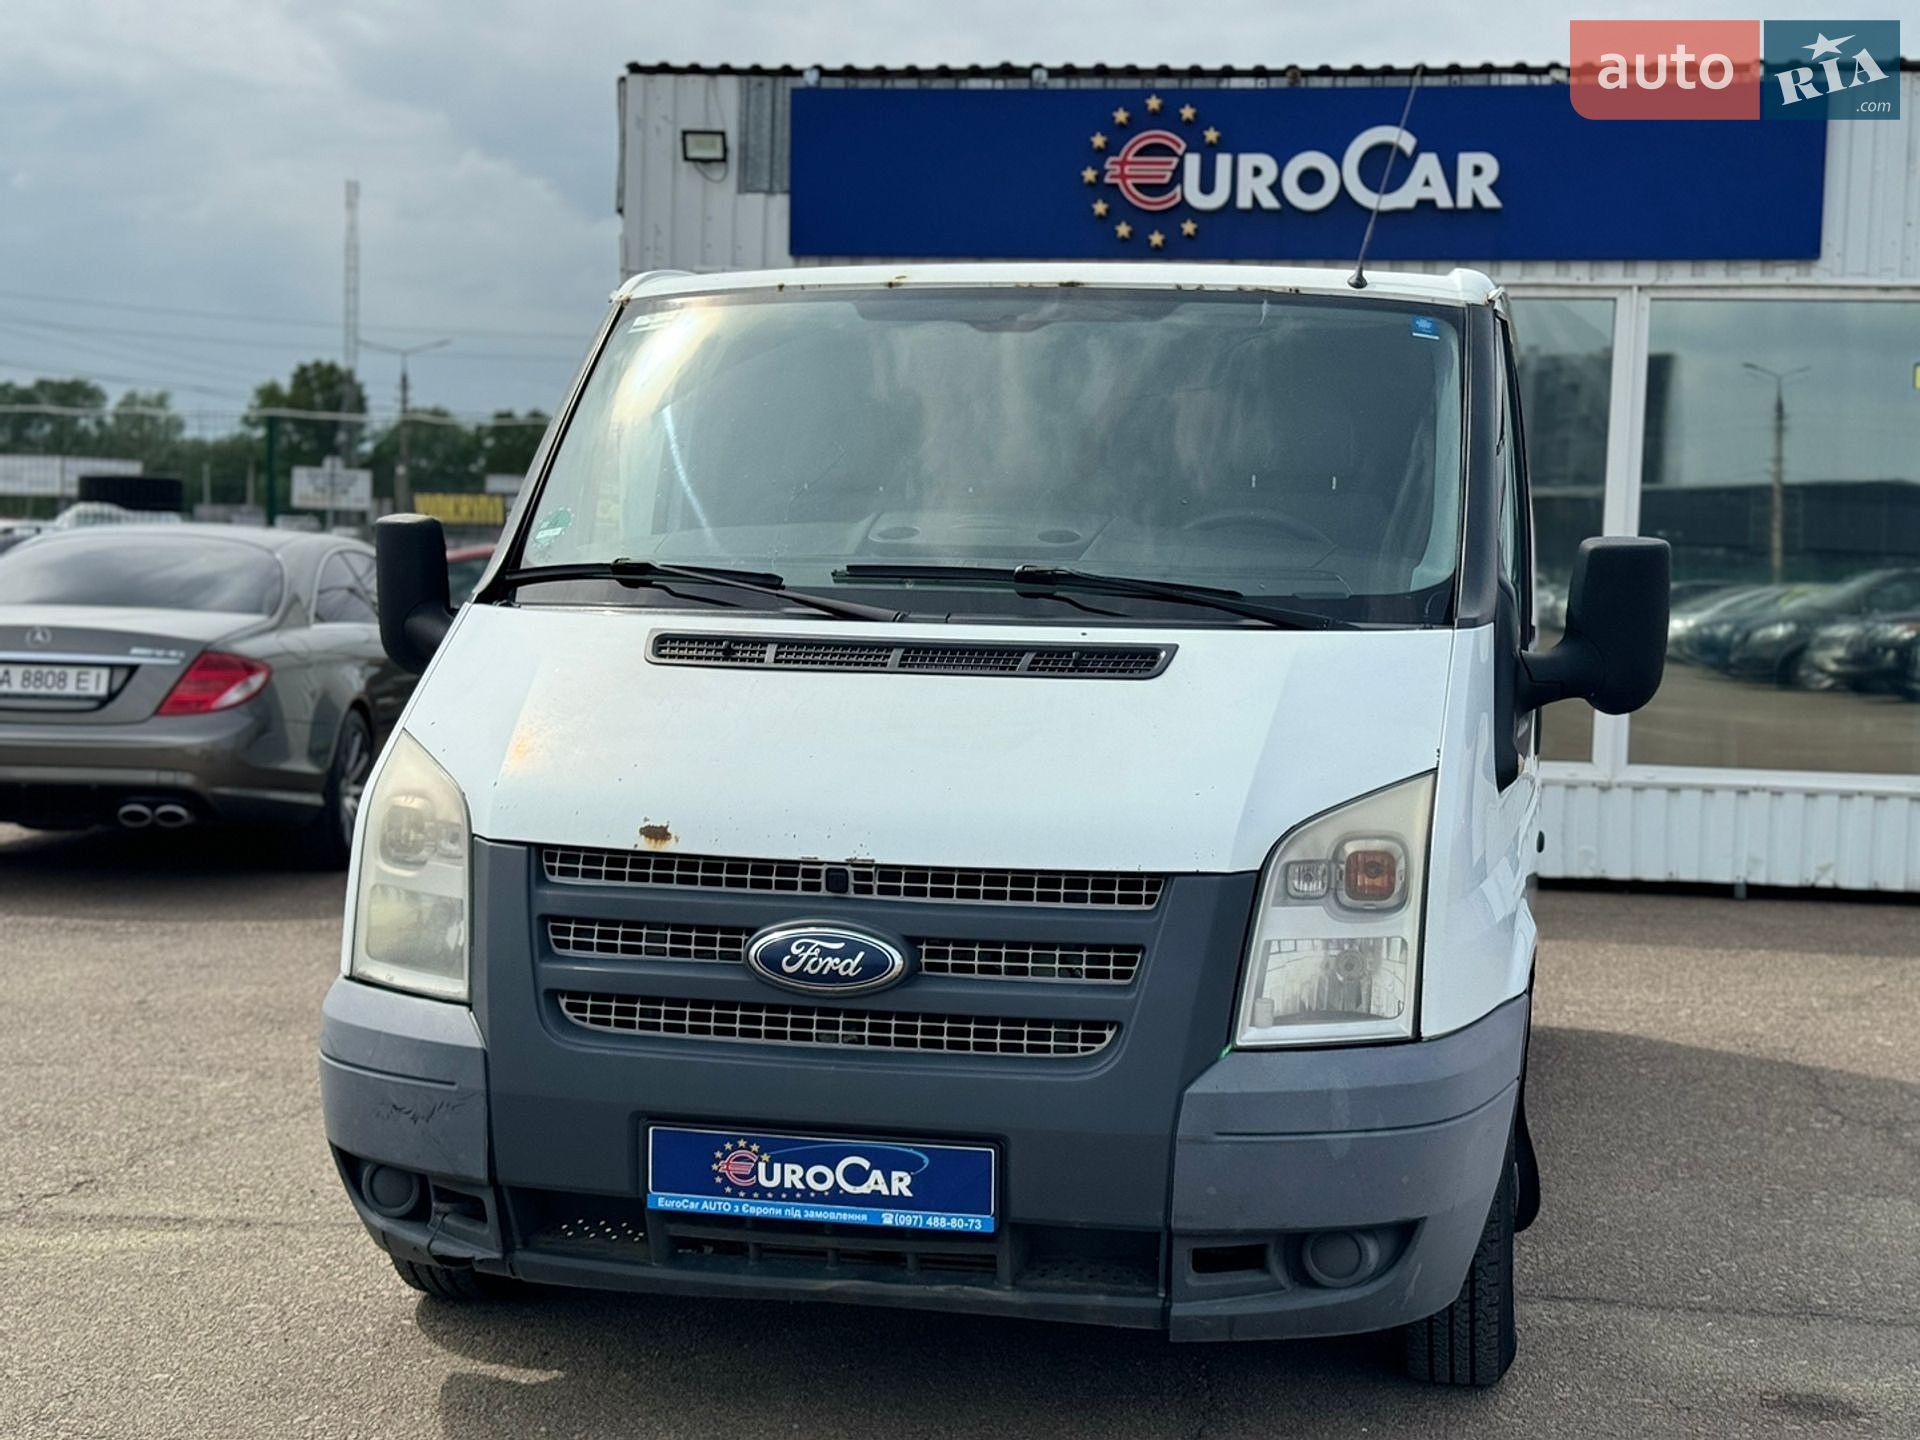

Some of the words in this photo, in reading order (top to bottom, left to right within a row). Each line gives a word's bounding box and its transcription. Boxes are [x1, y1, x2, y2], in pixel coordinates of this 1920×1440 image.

[21, 669, 68, 690] 8808
[781, 938, 865, 976] Ford
[657, 1197, 699, 1210] EuroCar
[741, 1205, 782, 1217] Європи
[784, 1207, 802, 1218] під
[803, 1211, 868, 1222] замовлення
[894, 1213, 923, 1228] (097)
[925, 1216, 982, 1230] 488-80-73
